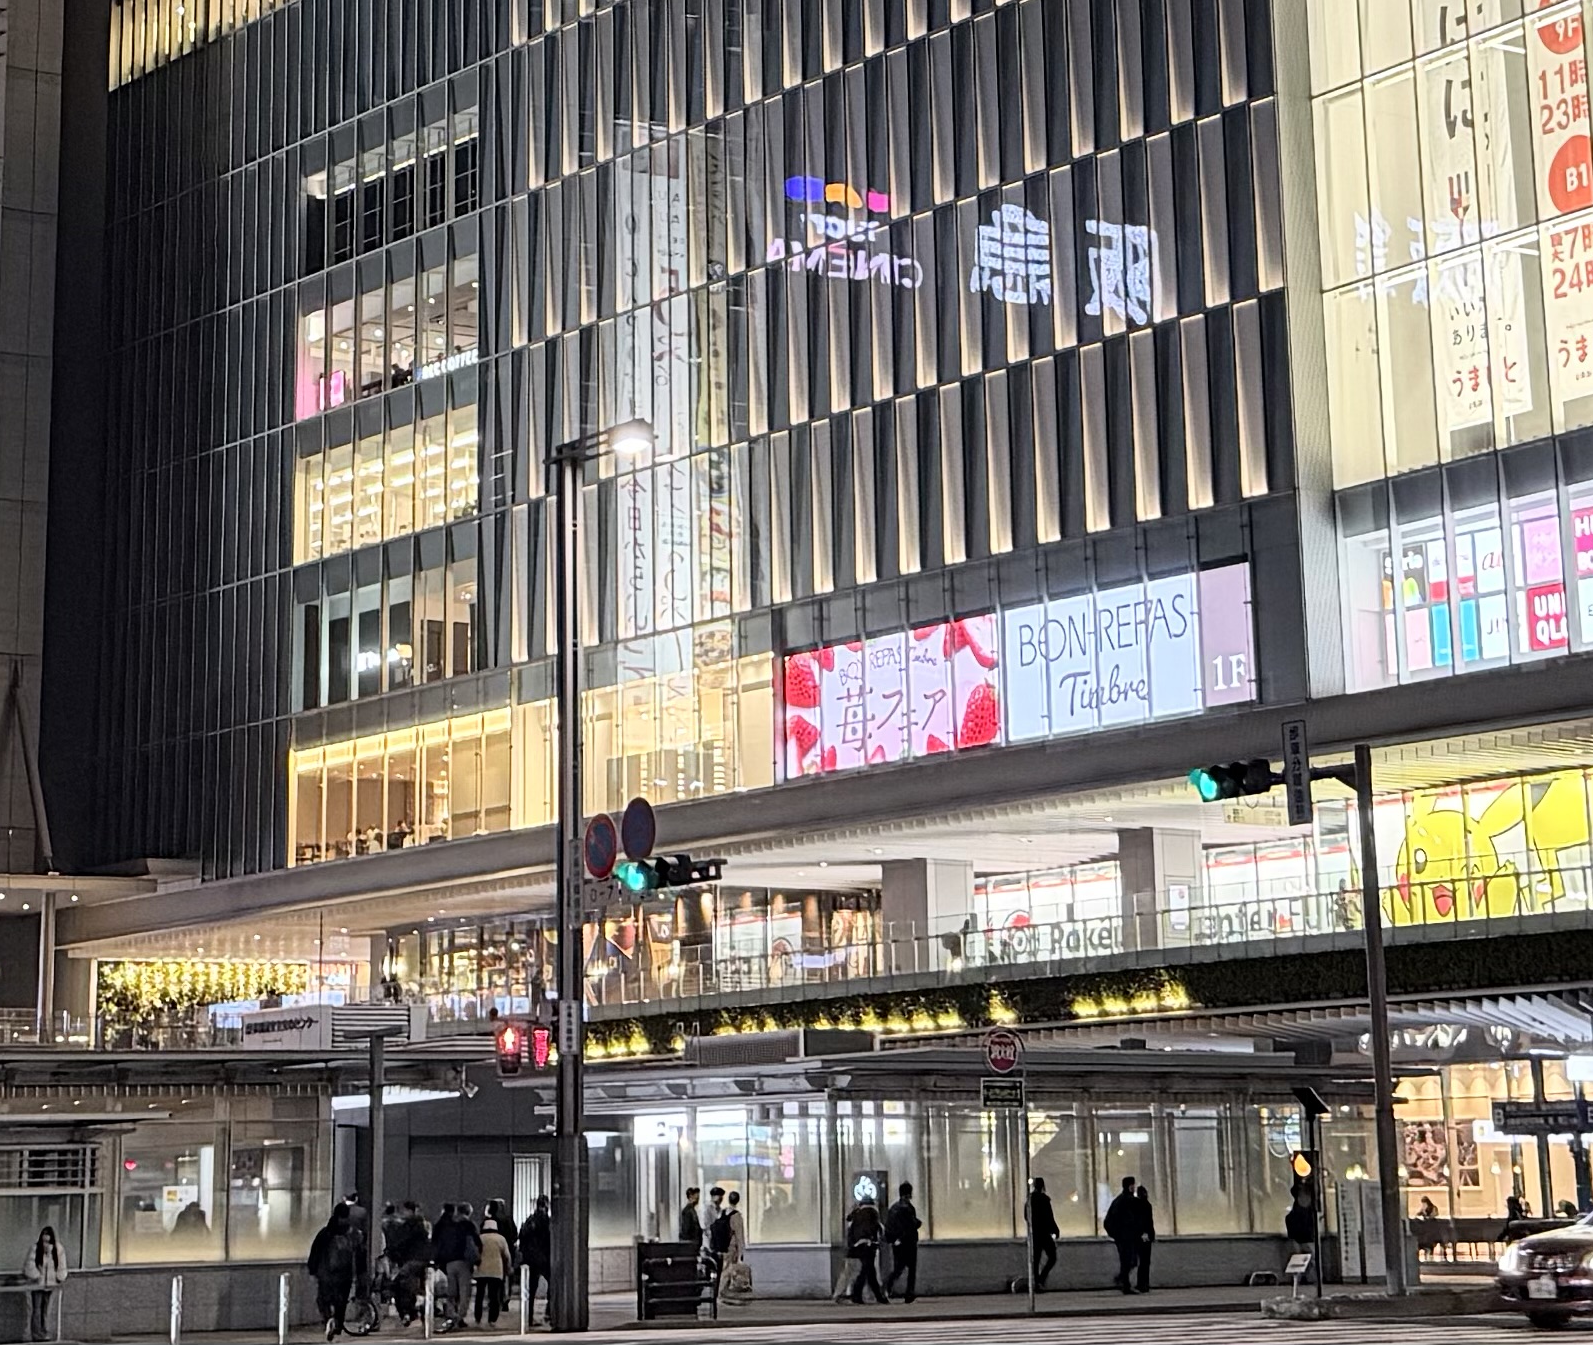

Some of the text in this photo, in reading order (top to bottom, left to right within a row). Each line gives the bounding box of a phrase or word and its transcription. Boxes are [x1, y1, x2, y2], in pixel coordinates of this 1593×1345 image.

[1019, 593, 1189, 669] BON REPAS
[1058, 663, 1151, 722] Timbre
[1212, 654, 1249, 691] 1F
